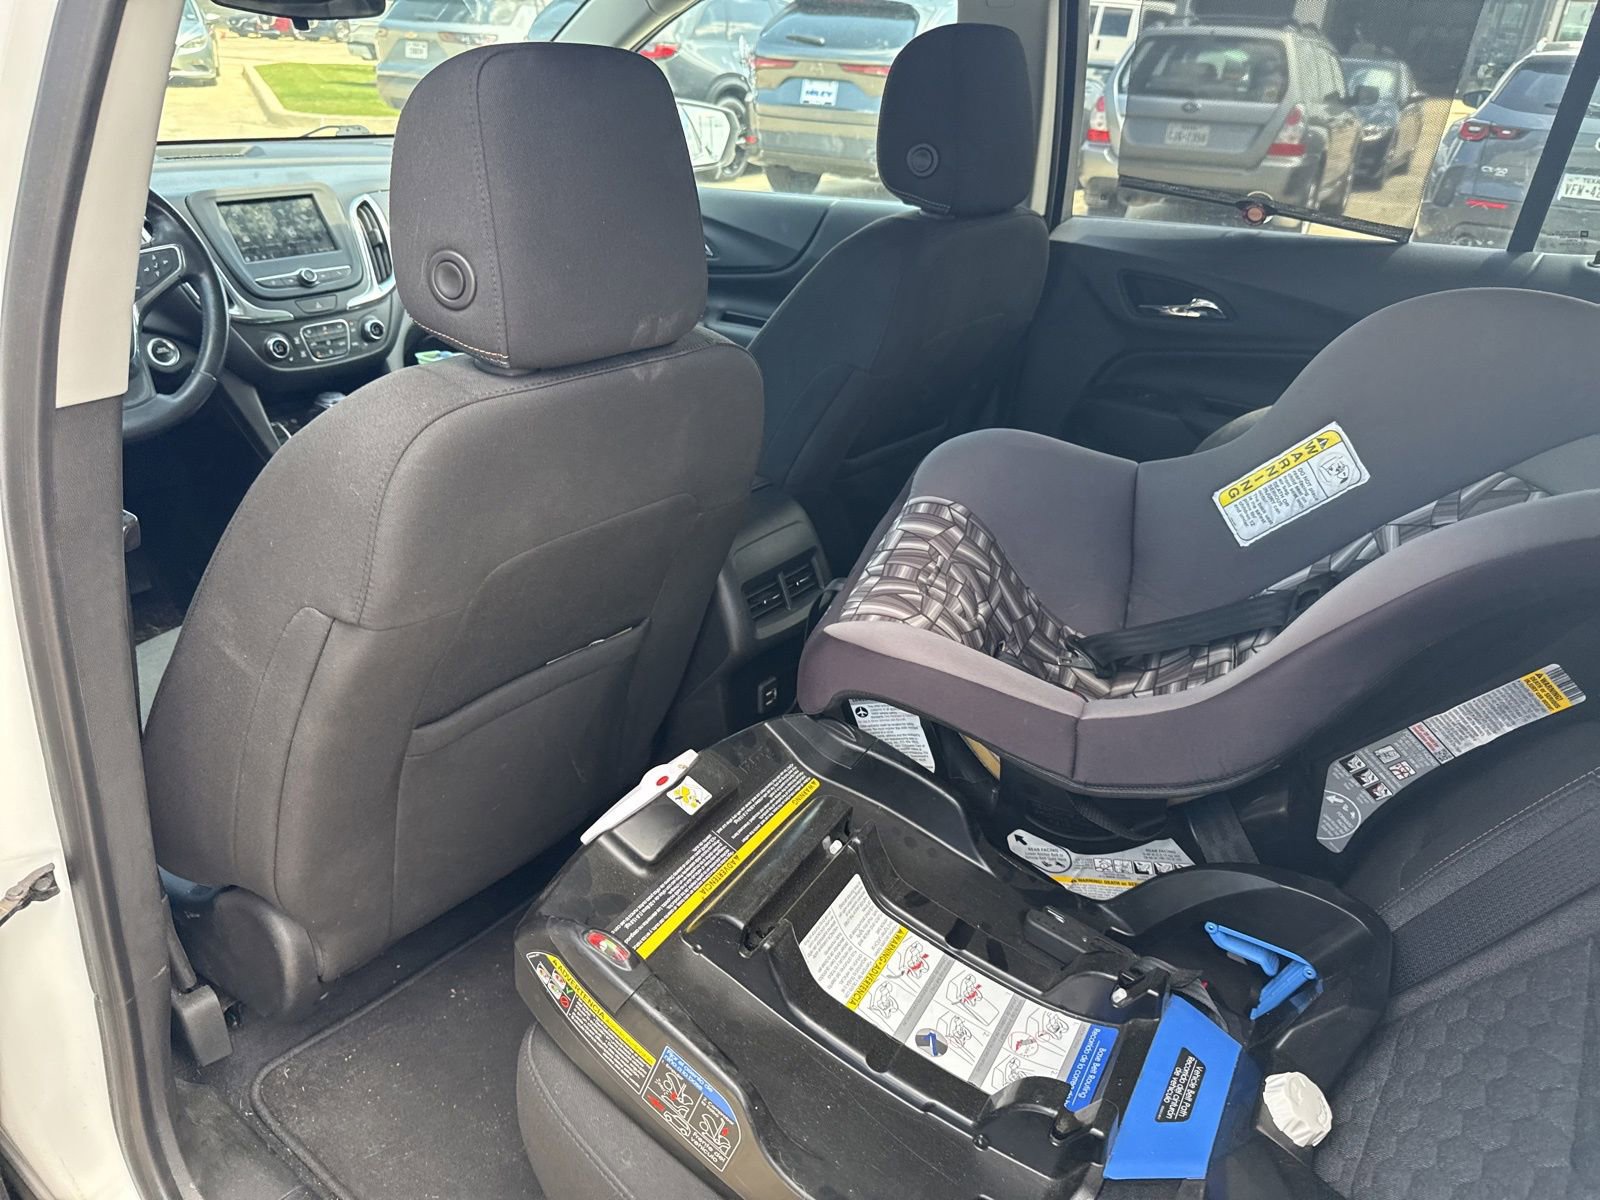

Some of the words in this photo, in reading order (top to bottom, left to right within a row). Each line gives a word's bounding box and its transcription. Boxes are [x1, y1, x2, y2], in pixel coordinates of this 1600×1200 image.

[1228, 441, 1318, 498] WARNING
[1266, 484, 1284, 507] SERIOUS
[1271, 481, 1285, 498] DEATH
[790, 784, 814, 805] WARNING
[699, 858, 736, 896] ADVERTENCIA
[880, 934, 900, 963] WARNING
[557, 963, 605, 1020] ADVERTENCIA
[848, 964, 881, 1006] ADVERTENCIA
[1084, 1028, 1101, 1054] Recorrido
[1095, 1048, 1106, 1062] Base
[1090, 1063, 1100, 1074] Belt
[1174, 1067, 1181, 1077] de
[1179, 1056, 1195, 1084] Recorrido
[1189, 1066, 1204, 1089] Vehicle
[1078, 1075, 1096, 1098] Routing
[1175, 1083, 1184, 1095] del
[1185, 1089, 1195, 1102] Belt
[1179, 1102, 1191, 1118] Path
[692, 1132, 713, 1152] Frente
[713, 1151, 726, 1163] del
